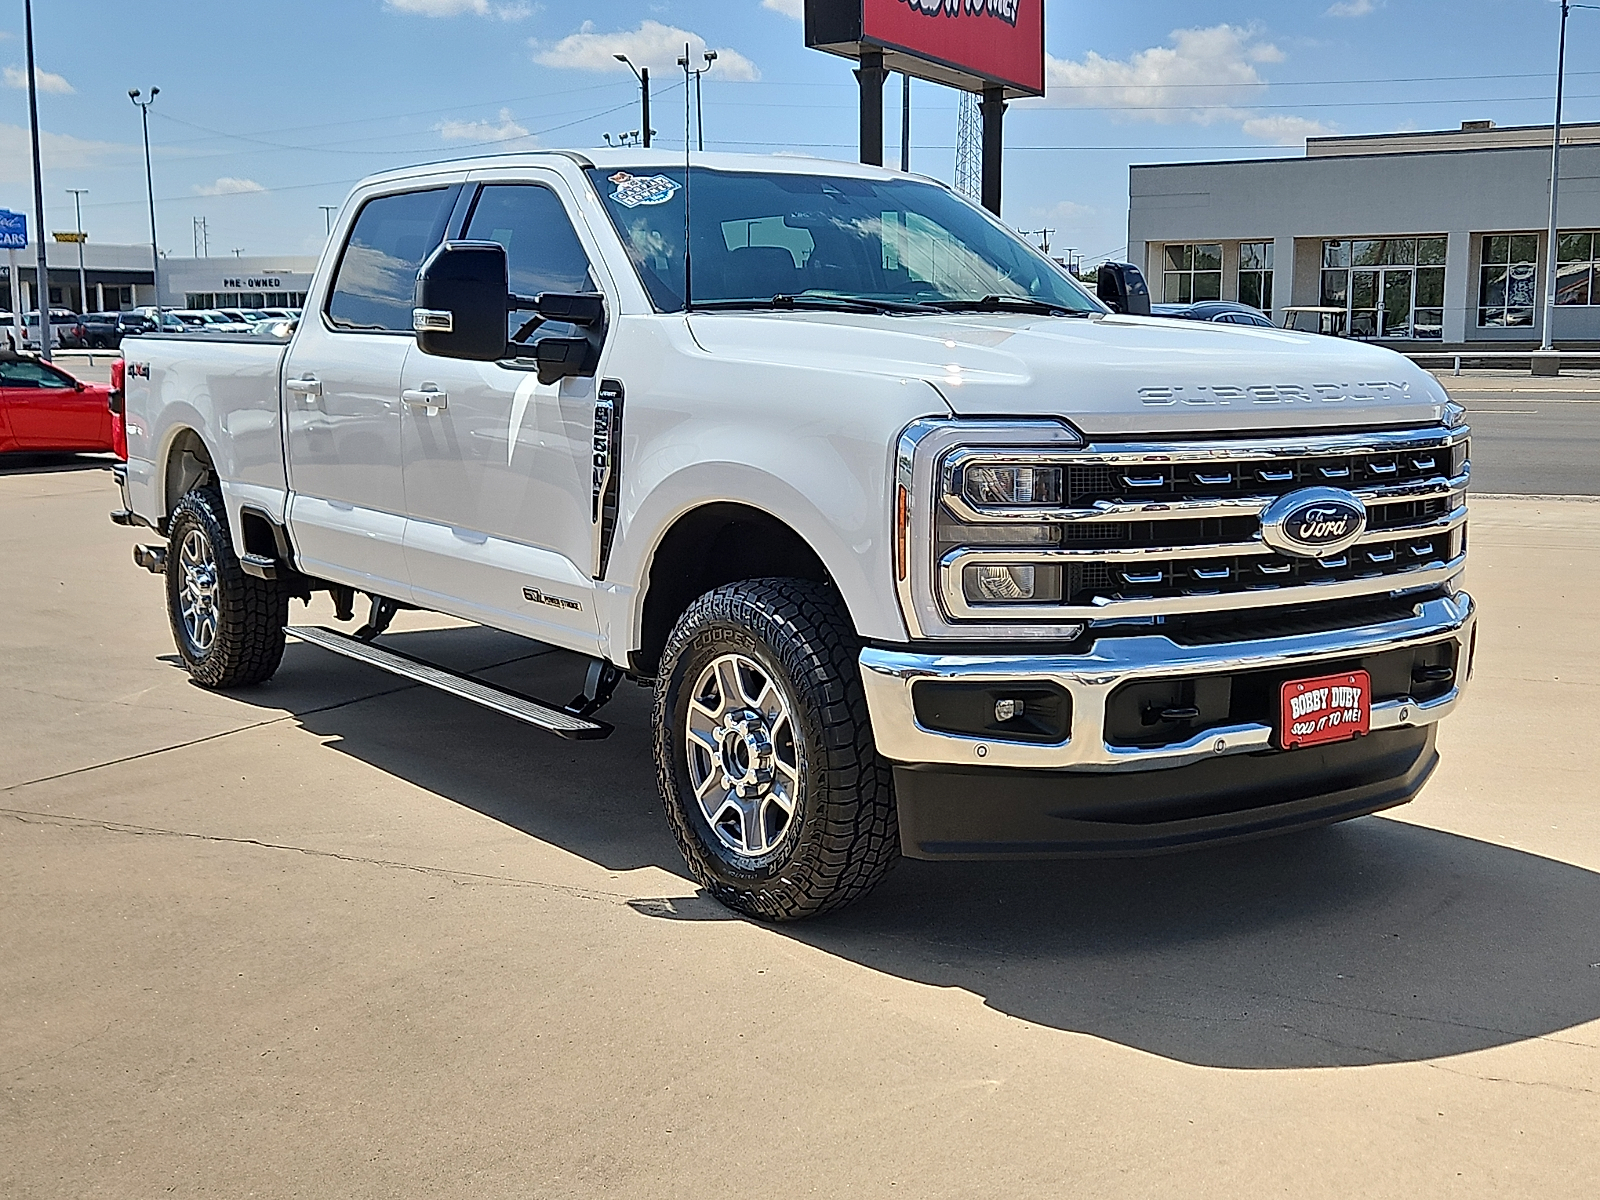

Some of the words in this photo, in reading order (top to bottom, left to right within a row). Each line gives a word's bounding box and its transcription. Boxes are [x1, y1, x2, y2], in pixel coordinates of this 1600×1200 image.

[223, 278, 281, 288] PRE-OWNED
[1137, 383, 1312, 406] SUPER
[1312, 381, 1411, 402] DUTY
[1300, 508, 1349, 539] Ford
[1290, 688, 1328, 719] BOBBY
[1330, 686, 1362, 709] DUBY
[1290, 721, 1316, 736] SOLD
[1316, 715, 1329, 732] IT
[1327, 711, 1342, 728] TO
[1341, 708, 1362, 723] ME!
